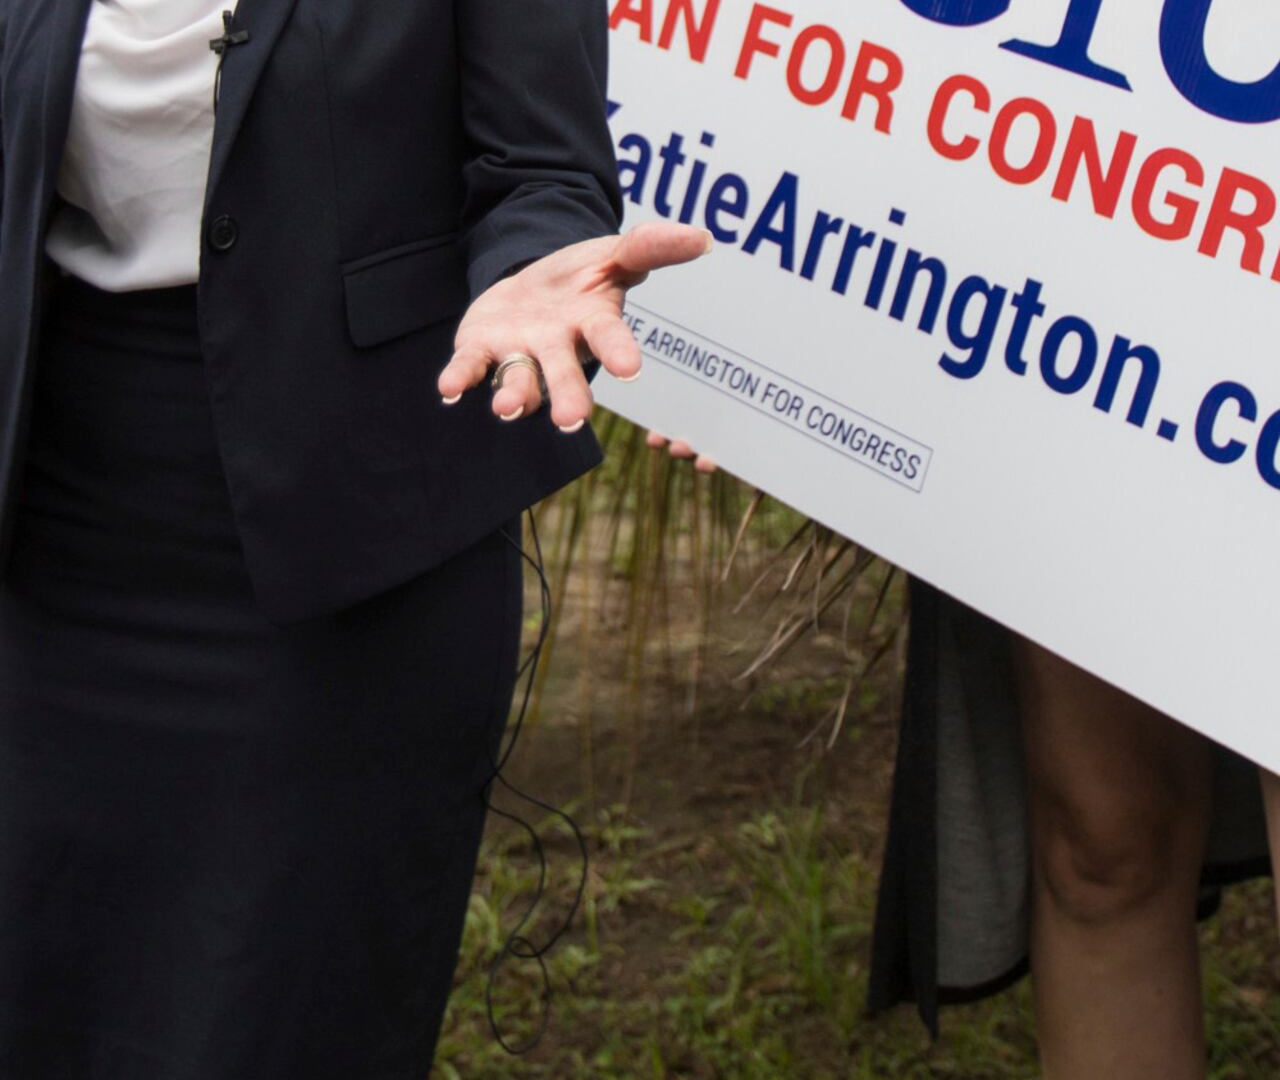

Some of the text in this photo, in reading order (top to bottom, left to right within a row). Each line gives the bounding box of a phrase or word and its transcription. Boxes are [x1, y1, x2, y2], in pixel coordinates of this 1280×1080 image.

[733, 1, 905, 136] FOR
[643, 325, 761, 400] ARRINGTON
[760, 381, 807, 421] FOR
[805, 405, 923, 481] CONGRESS
